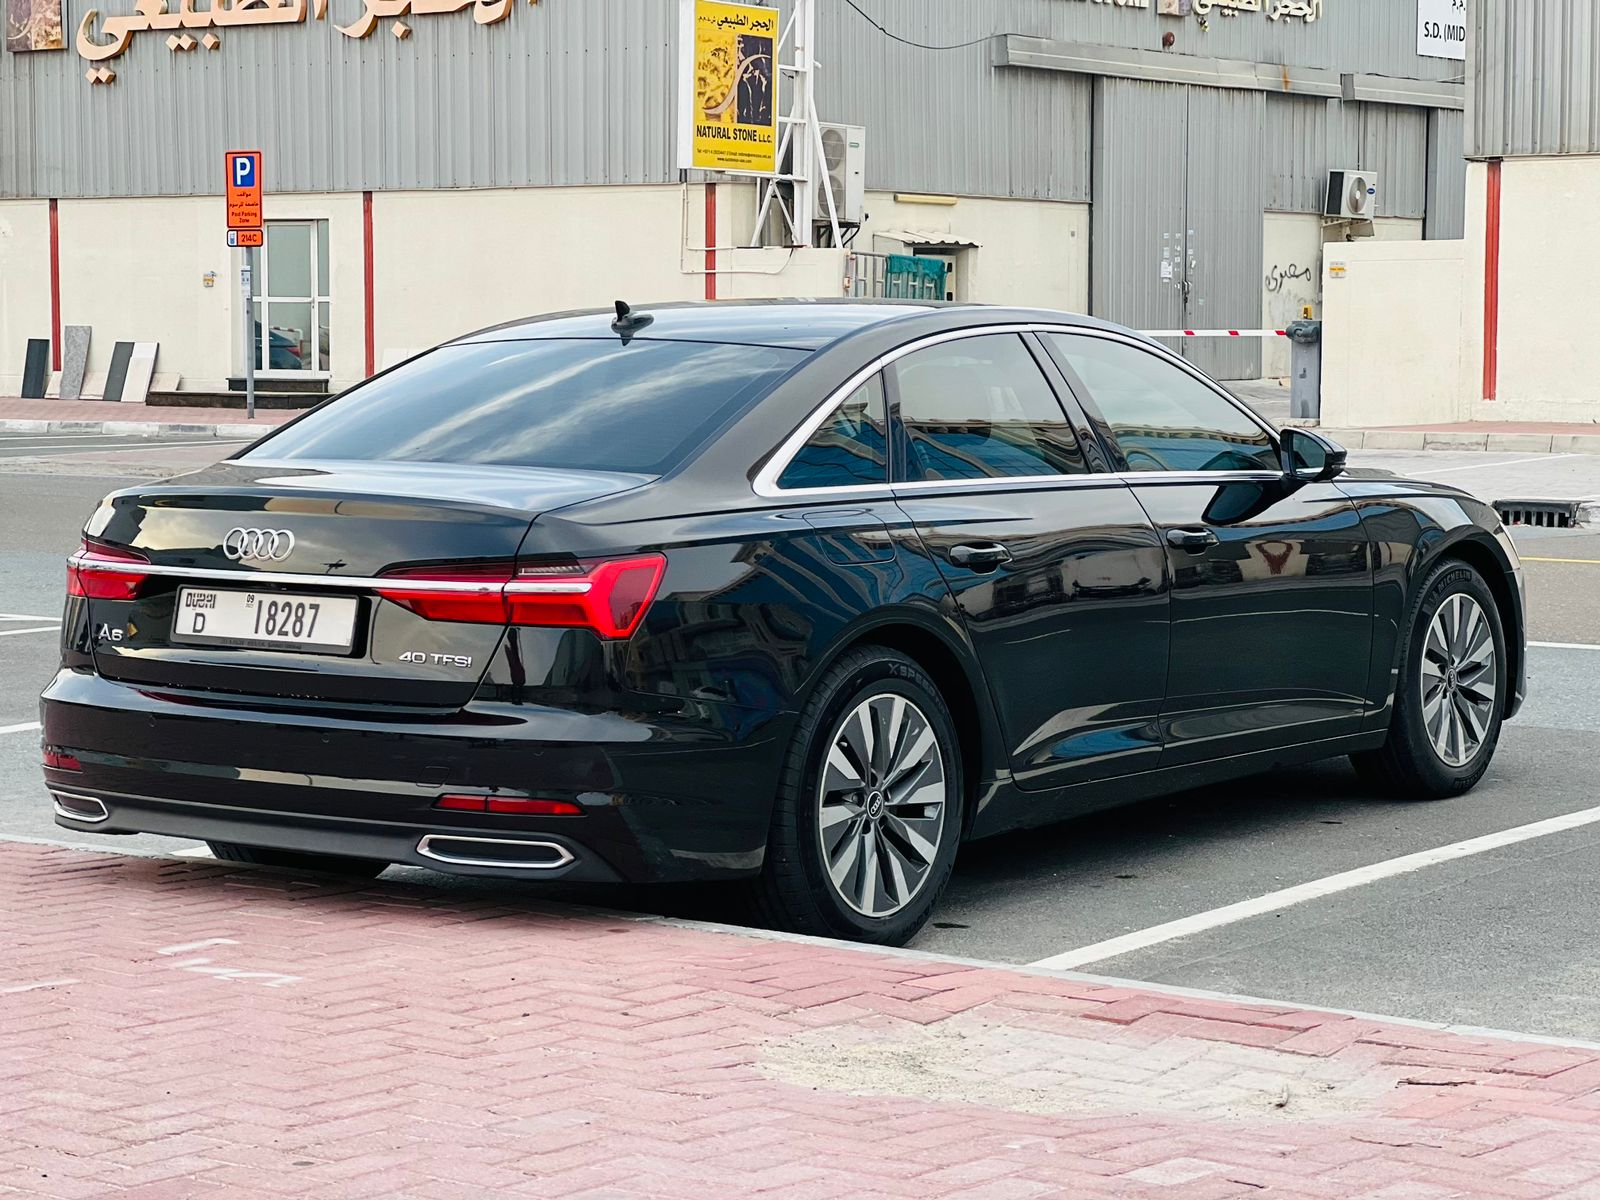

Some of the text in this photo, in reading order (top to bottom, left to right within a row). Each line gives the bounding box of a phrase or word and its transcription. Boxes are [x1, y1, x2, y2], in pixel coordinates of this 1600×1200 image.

[717, 13, 749, 30] الطبيعي
[749, 18, 774, 31] الحجر
[1424, 21, 1442, 39] S.D.
[696, 125, 731, 140] NATURAL
[732, 128, 757, 142] STONE
[235, 157, 251, 185] P
[241, 234, 257, 242] 214C
[246, 593, 255, 604] 09
[192, 612, 206, 634] D
[254, 599, 320, 638] 18287
[98, 623, 124, 641] A6
[398, 651, 472, 668] 40 TFSI
